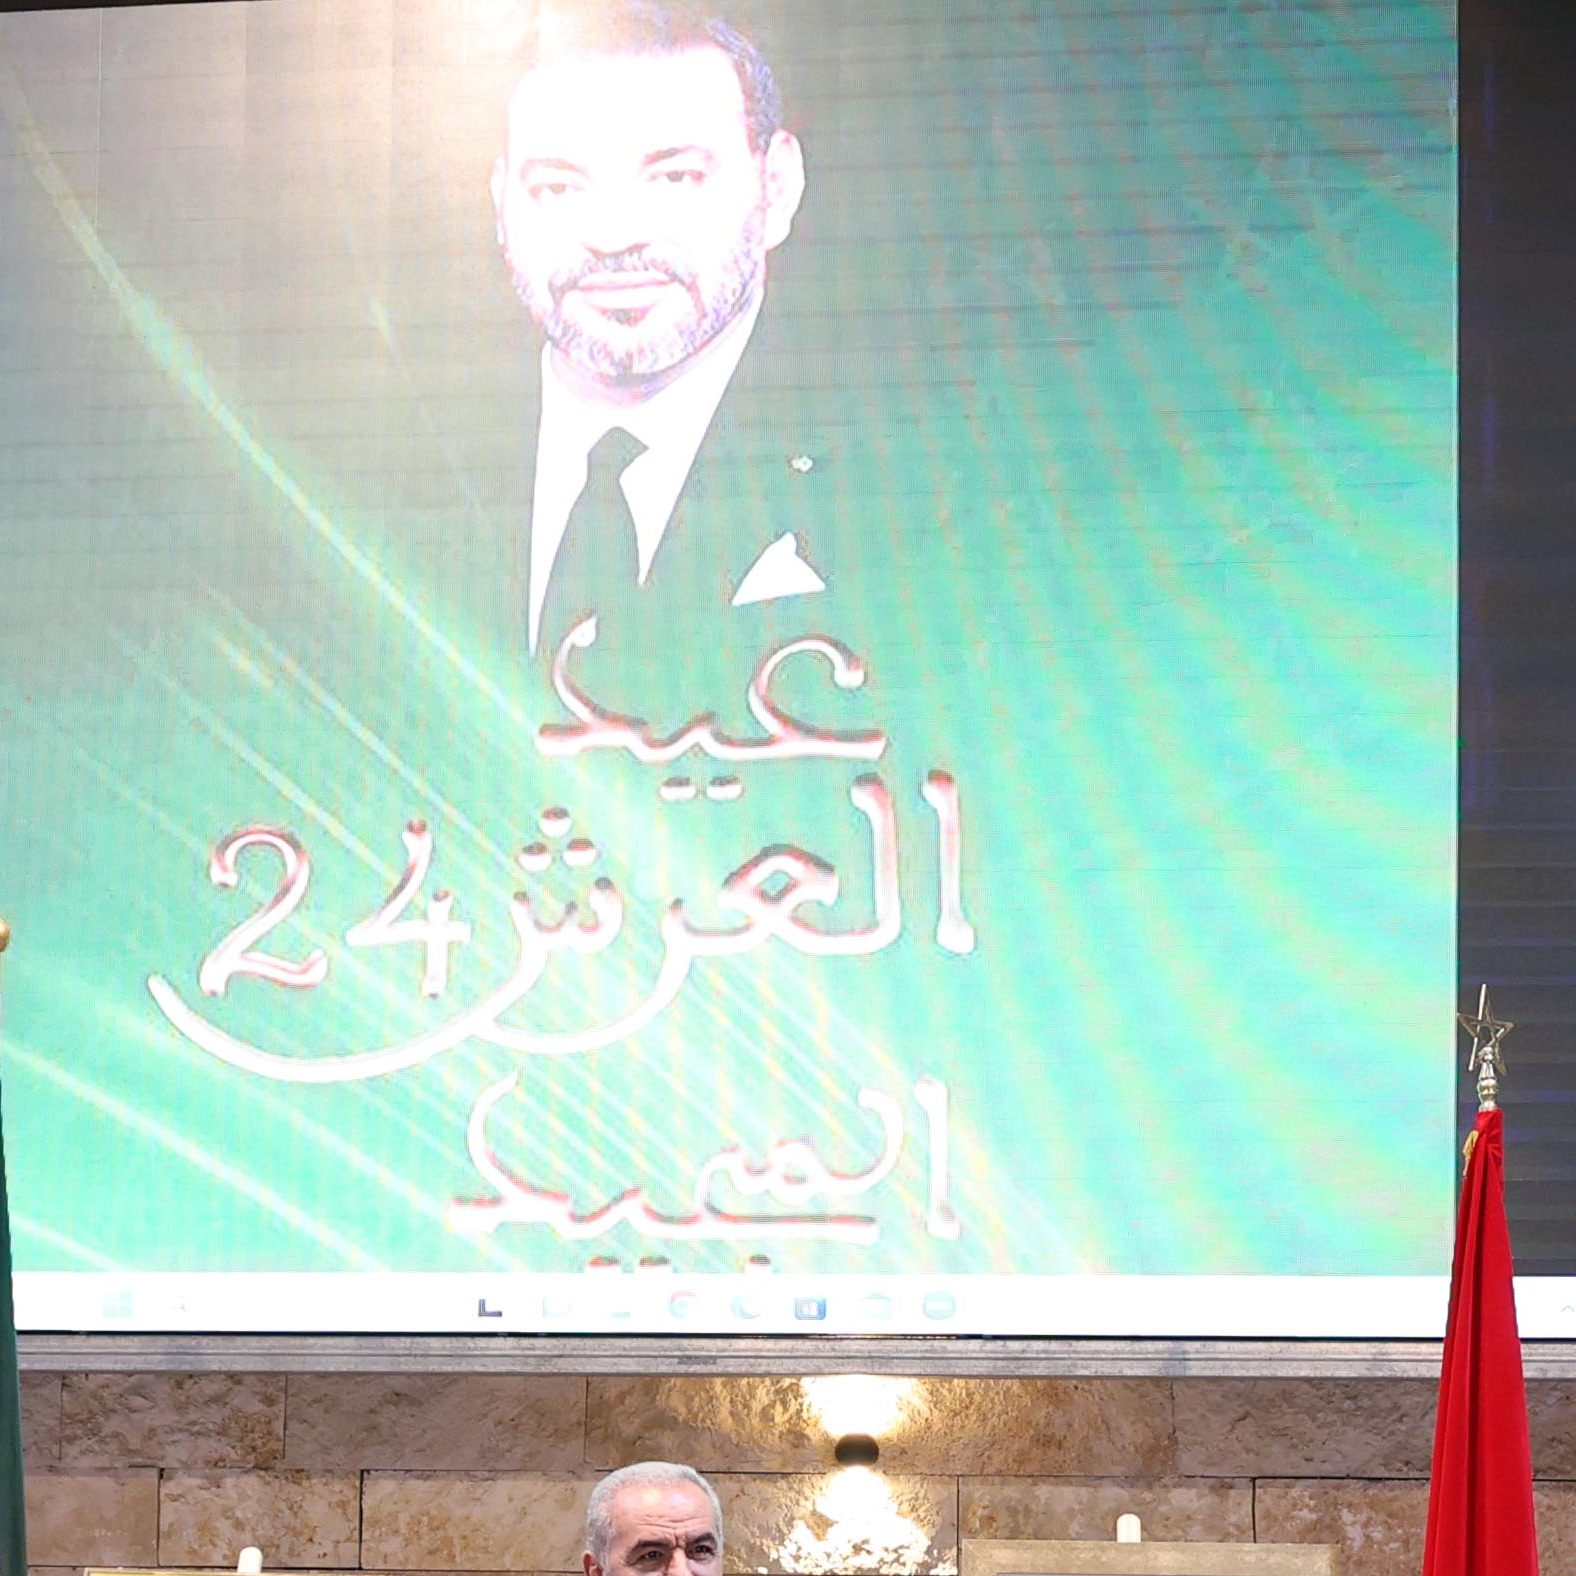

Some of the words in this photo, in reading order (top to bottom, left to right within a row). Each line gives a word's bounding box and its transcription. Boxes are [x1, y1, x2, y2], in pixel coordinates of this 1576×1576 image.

[535, 612, 886, 801] عيد
[147, 770, 976, 1083] العرش
[197, 819, 471, 999] 24
